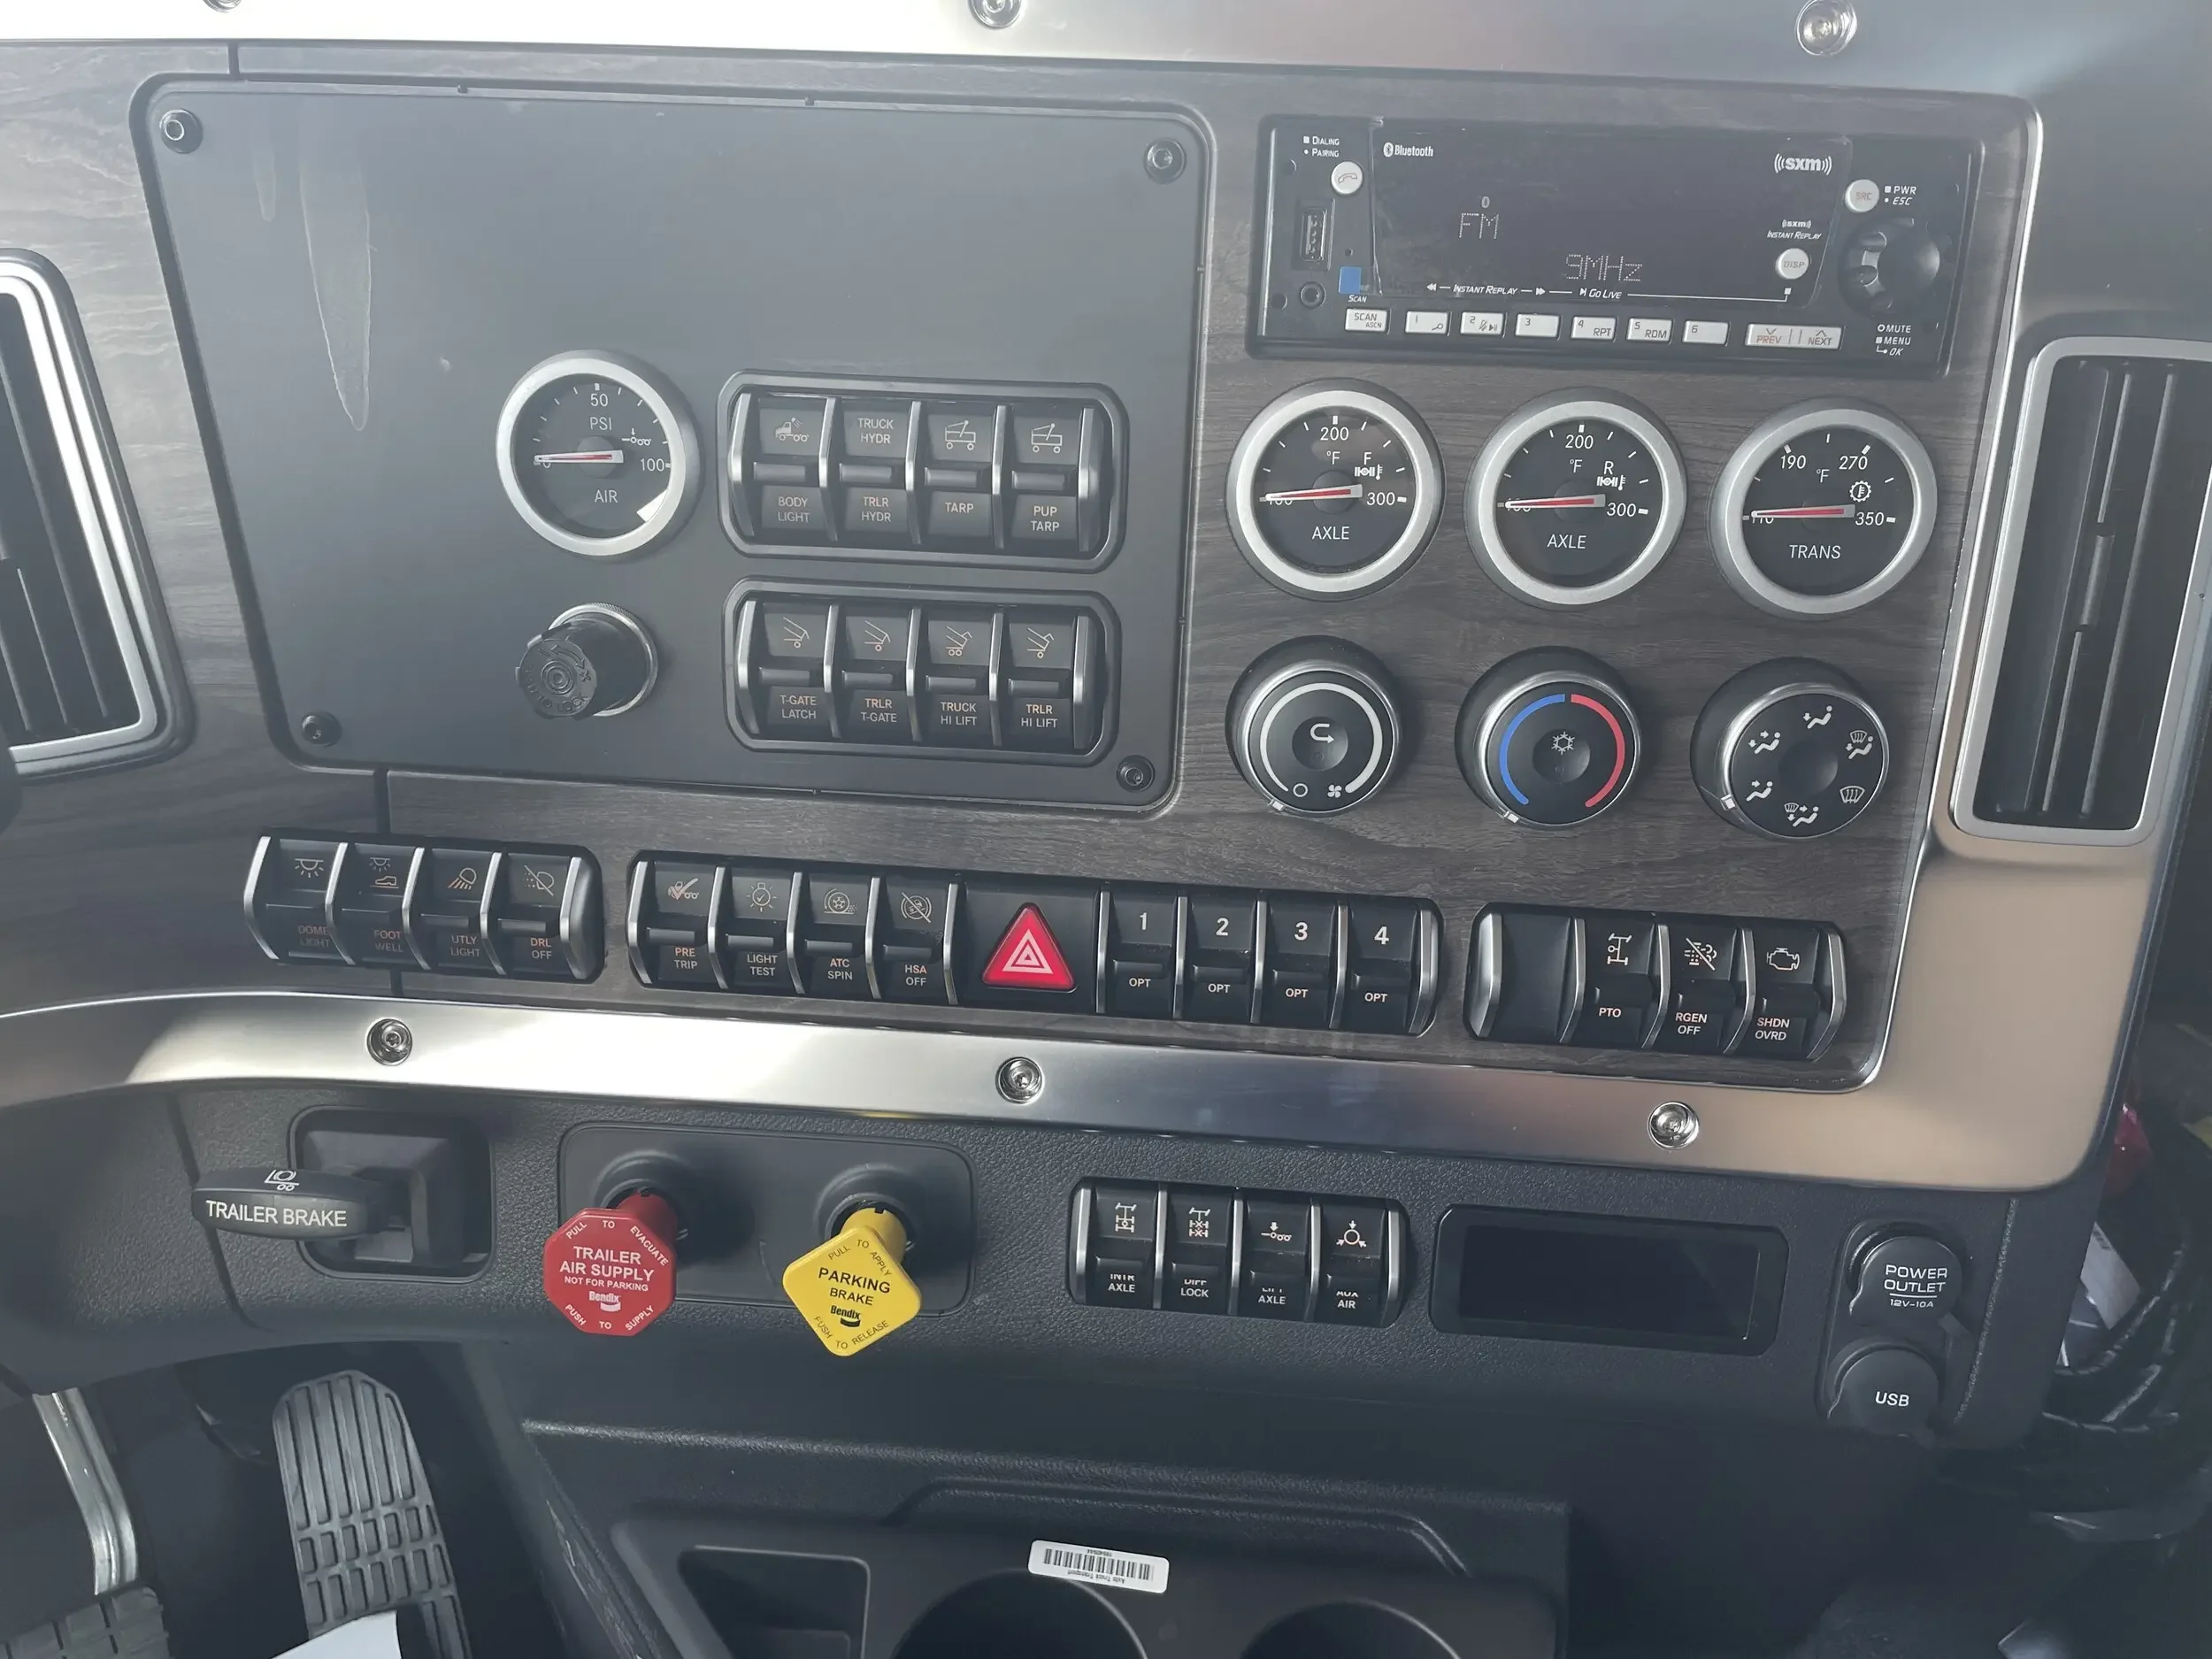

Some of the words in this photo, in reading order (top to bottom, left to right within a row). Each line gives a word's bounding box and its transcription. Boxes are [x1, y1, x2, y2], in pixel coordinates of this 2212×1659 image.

[1394, 145, 1433, 157] Bluetooth
[1856, 191, 1872, 200] SRC
[1893, 186, 1916, 195] PWR
[1893, 196, 1913, 205] ESC
[1458, 212, 1499, 239] FM
[1354, 312, 1377, 322] SCAN
[1525, 317, 1532, 326] 3
[1578, 320, 1585, 329] 4
[1634, 322, 1640, 331] 5
[1691, 325, 1699, 334] 6
[1886, 324, 1911, 333] MUTE
[1593, 327, 1612, 337] RPT
[1644, 329, 1667, 339] RDM
[1755, 334, 1782, 345] PREV
[1808, 336, 1833, 346] NEXT
[1883, 336, 1911, 345] MENU
[1889, 347, 1904, 356] OK
[590, 393, 609, 407] 50
[589, 417, 612, 430] PSI
[857, 417, 894, 431] TRUCK
[860, 433, 891, 444] HYDR
[1320, 426, 1350, 442] 200
[1564, 434, 1594, 450] 200
[1363, 451, 1371, 465] F
[1780, 455, 1807, 470] 190
[1839, 456, 1869, 471] 270
[640, 458, 664, 472] 100
[1603, 460, 1615, 475] R
[594, 490, 618, 503] AIR
[778, 495, 808, 508] BODY
[863, 495, 889, 508] TRLR
[1366, 491, 1396, 507] 300
[945, 502, 974, 515] TARP
[1033, 504, 1058, 517] PUP
[1606, 503, 1637, 518] 300
[777, 511, 810, 524] LIGHT
[862, 511, 892, 524] HYDR
[1855, 511, 1885, 526] 350
[1030, 520, 1060, 533] TARP
[1311, 526, 1350, 541] AXLE
[1547, 534, 1587, 549] AXLE
[1789, 544, 1842, 559] TRANS
[780, 695, 817, 707] T-GATE
[864, 697, 893, 710] TRLR
[940, 701, 977, 714] TRUCK
[781, 708, 817, 720] LATCH
[1025, 703, 1053, 716] TRLR
[860, 711, 897, 724] T-GATE
[940, 715, 953, 726] HI
[956, 715, 977, 727] LIFT
[1021, 717, 1033, 728] HI
[1036, 718, 1058, 730] LIFT
[1139, 911, 1148, 931] 1
[1216, 917, 1230, 936] 2
[297, 925, 329, 936] DOME
[373, 929, 403, 941] FOOT
[1294, 922, 1308, 941] 3
[1373, 926, 1389, 945] 4
[299, 936, 331, 949] LIGHT
[451, 934, 477, 947] UTLY
[530, 937, 552, 949] DRL
[375, 941, 403, 954] WELL
[449, 947, 481, 959] LIGHT
[674, 947, 696, 958] PRE
[531, 949, 552, 961] OFF
[747, 953, 779, 966] LIGHT
[673, 959, 697, 971] TRIP
[830, 957, 850, 970] ATC
[904, 963, 928, 975] HSA
[749, 965, 776, 977] TEST
[827, 969, 853, 982] SPIN
[906, 975, 927, 987] OFF
[1129, 977, 1151, 989] OPT
[1207, 982, 1230, 995] OPT
[1285, 987, 1309, 1000] OPT
[1364, 992, 1387, 1003] OPT
[1598, 1007, 1621, 1019] PTO
[1675, 1012, 1708, 1025] RGEN
[1755, 1017, 1790, 1030] SHDN
[1678, 1025, 1701, 1037] OFF
[1755, 1030, 1787, 1041] OVRD
[205, 1200, 278, 1225] TRAILER
[283, 1208, 347, 1228] BRAKE
[566, 1221, 588, 1239] PULL
[602, 1219, 615, 1229] TO
[630, 1225, 669, 1267] EVACUATE
[573, 1246, 641, 1265] TRAILER
[828, 1246, 850, 1260] PULL
[856, 1239, 869, 1248] TO
[870, 1251, 892, 1277] APPLY
[559, 1260, 586, 1275] AIR
[591, 1263, 655, 1282] SUPPLY
[1885, 1263, 1948, 1279] POWER
[565, 1276, 583, 1285] NOT
[586, 1278, 605, 1287] FOR
[607, 1279, 649, 1292] PARKING
[818, 1267, 891, 1294] PARKING
[1884, 1279, 1947, 1294] OUTLET
[1108, 1283, 1136, 1294] AXLE
[1180, 1286, 1209, 1298] LOCK
[589, 1290, 619, 1303] Bendix
[830, 1286, 874, 1306] BRAKE
[1257, 1294, 1286, 1305] AXLE
[1337, 1299, 1356, 1310] AIR
[1890, 1298, 1934, 1309] 12V-10A
[565, 1304, 588, 1326] PUSH
[598, 1321, 612, 1330] TO
[625, 1304, 655, 1331] SUPPLY
[830, 1304, 860, 1320] Bendix
[814, 1316, 833, 1340] PUSH
[835, 1340, 848, 1349] TO
[851, 1320, 890, 1346] RELEASE
[1875, 1391, 1909, 1407] USB
